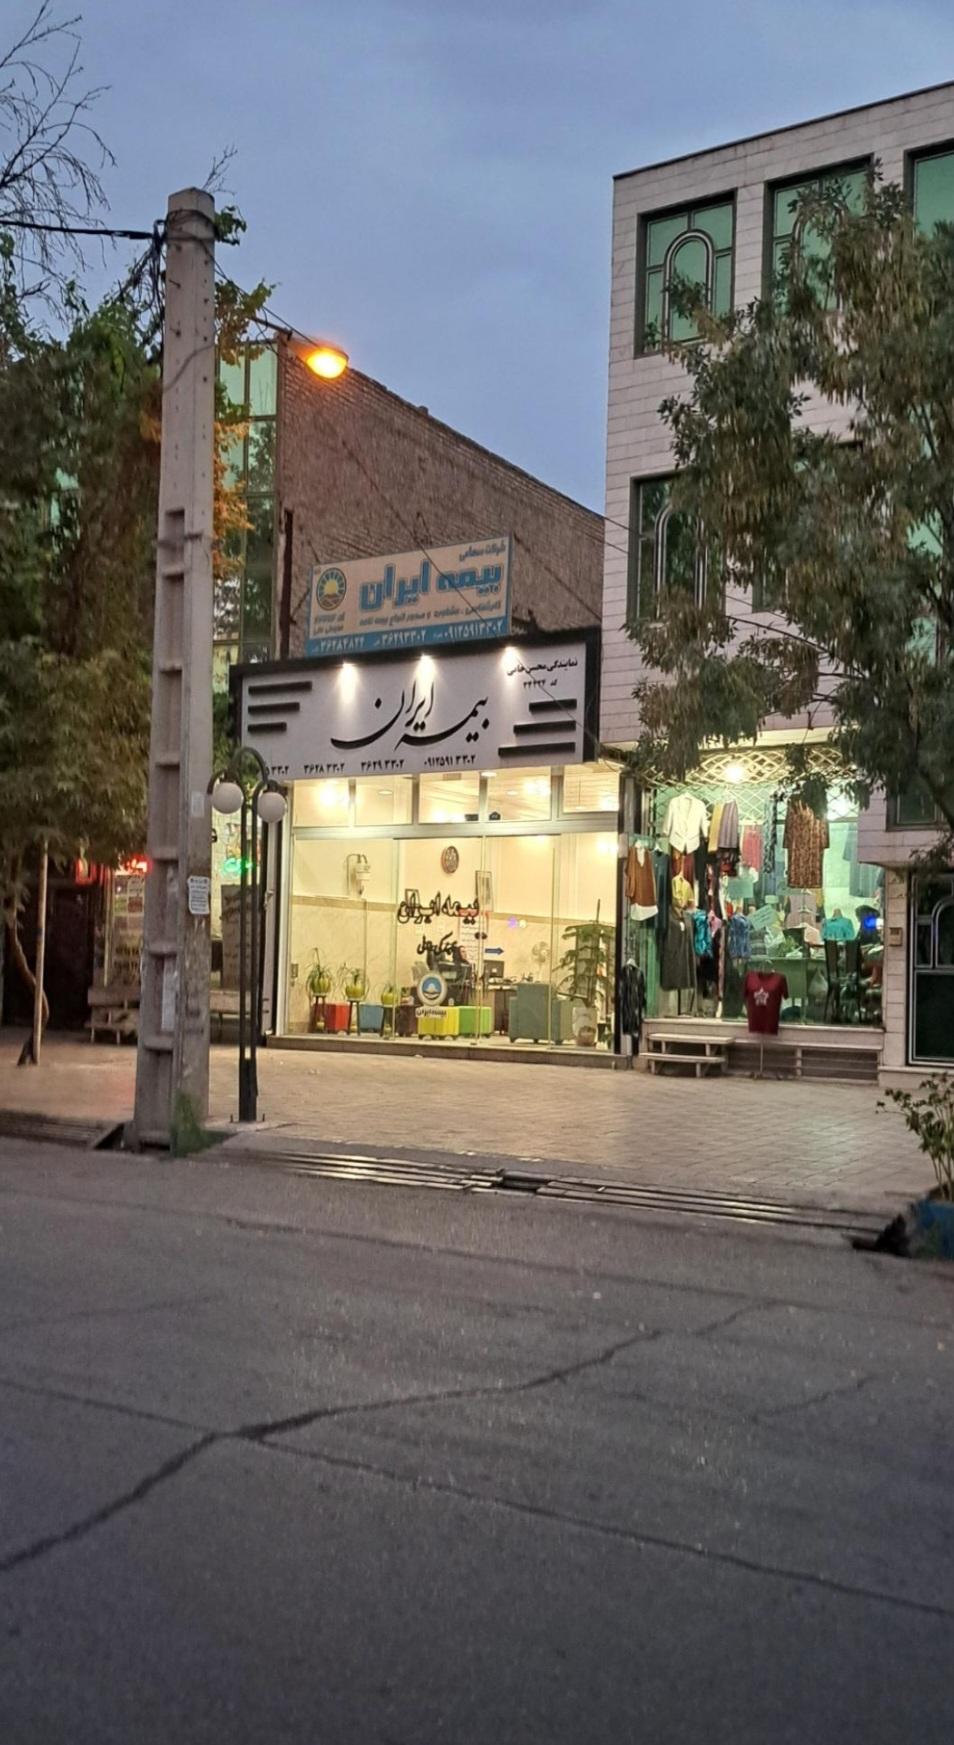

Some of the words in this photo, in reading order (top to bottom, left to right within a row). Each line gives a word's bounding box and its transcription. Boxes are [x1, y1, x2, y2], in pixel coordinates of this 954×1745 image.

[360, 559, 430, 612] ایران
[331, 680, 434, 750] ایران
[394, 697, 490, 752] بیمه
